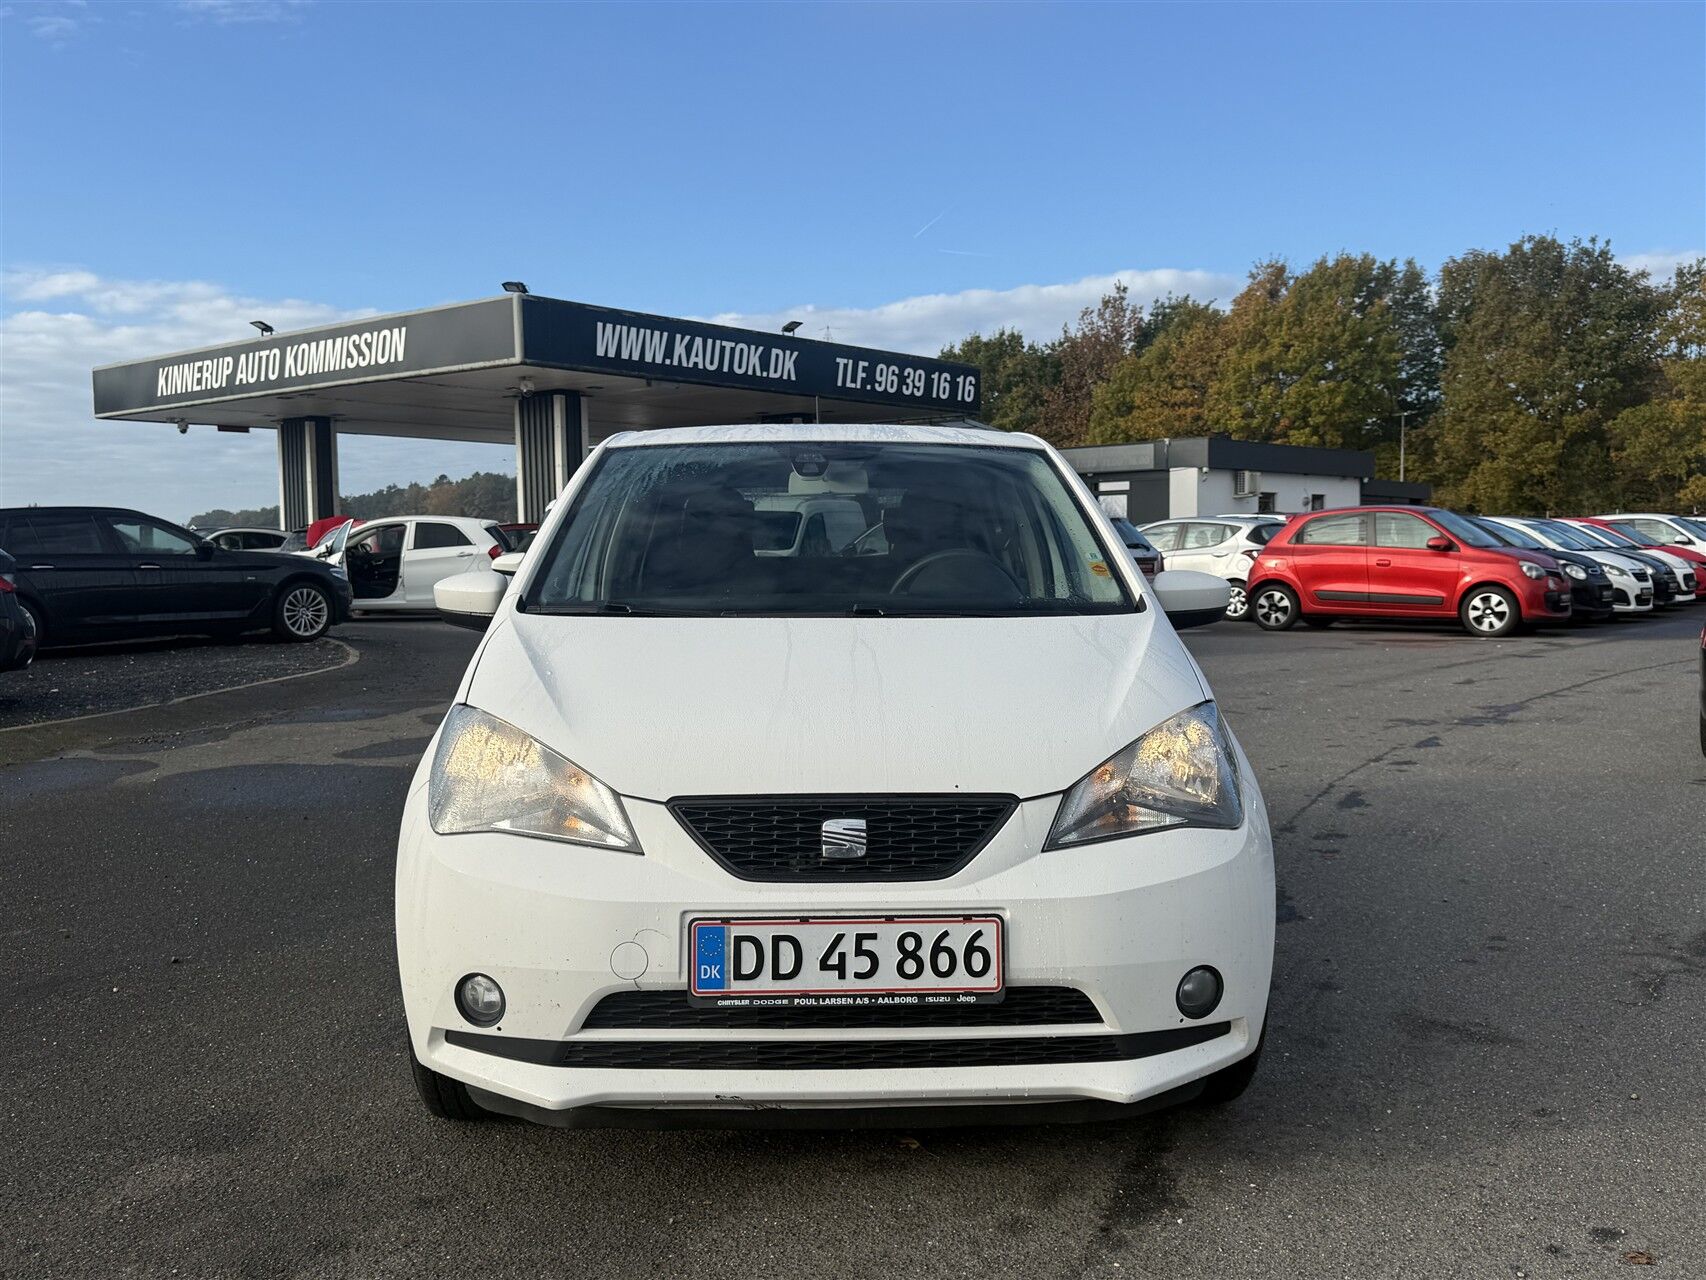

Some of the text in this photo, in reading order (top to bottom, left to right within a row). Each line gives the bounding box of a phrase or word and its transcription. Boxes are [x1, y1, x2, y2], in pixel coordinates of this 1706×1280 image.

[157, 326, 407, 398] KINNERUP AUTO KOMMISSION
[596, 322, 976, 403] WWW.KAUTOK.DK TLF. 96 39 16 16
[701, 964, 721, 979] DK
[733, 929, 991, 981] DD 45 866
[819, 997, 854, 1005] LARSEN
[855, 997, 870, 1005] A/S
[877, 996, 919, 1004] AALBORG
[956, 995, 977, 1004] Jeep
